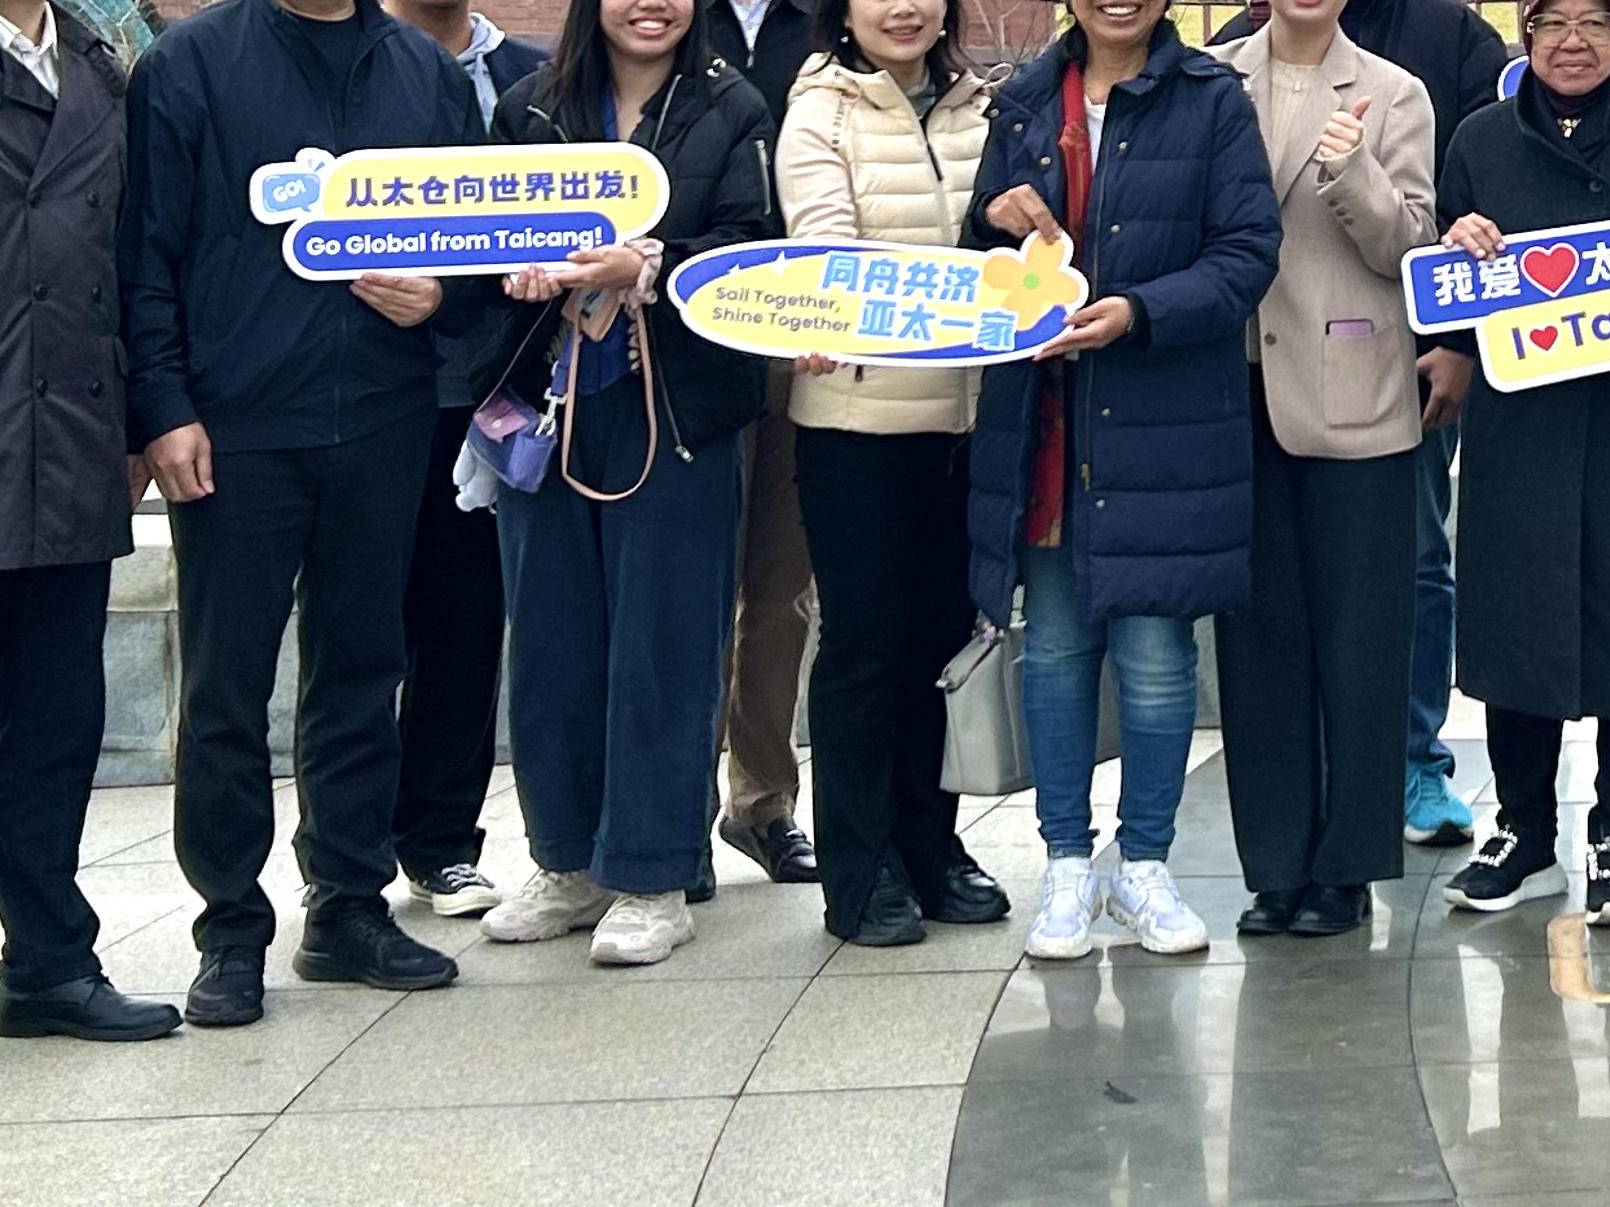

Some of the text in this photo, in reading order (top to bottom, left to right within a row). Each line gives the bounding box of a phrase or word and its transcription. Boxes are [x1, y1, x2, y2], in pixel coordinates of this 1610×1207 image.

[345, 169, 638, 208] 从太仓向世界出发!
[305, 226, 603, 256] Go Global from Taicang!
[820, 252, 981, 303] 同舟共济
[1432, 254, 1521, 306] 我爱
[716, 287, 841, 313] Sail Together,
[712, 307, 851, 331] Shine Together
[857, 299, 1018, 351] 亚太一家
[1512, 326, 1527, 360] I
